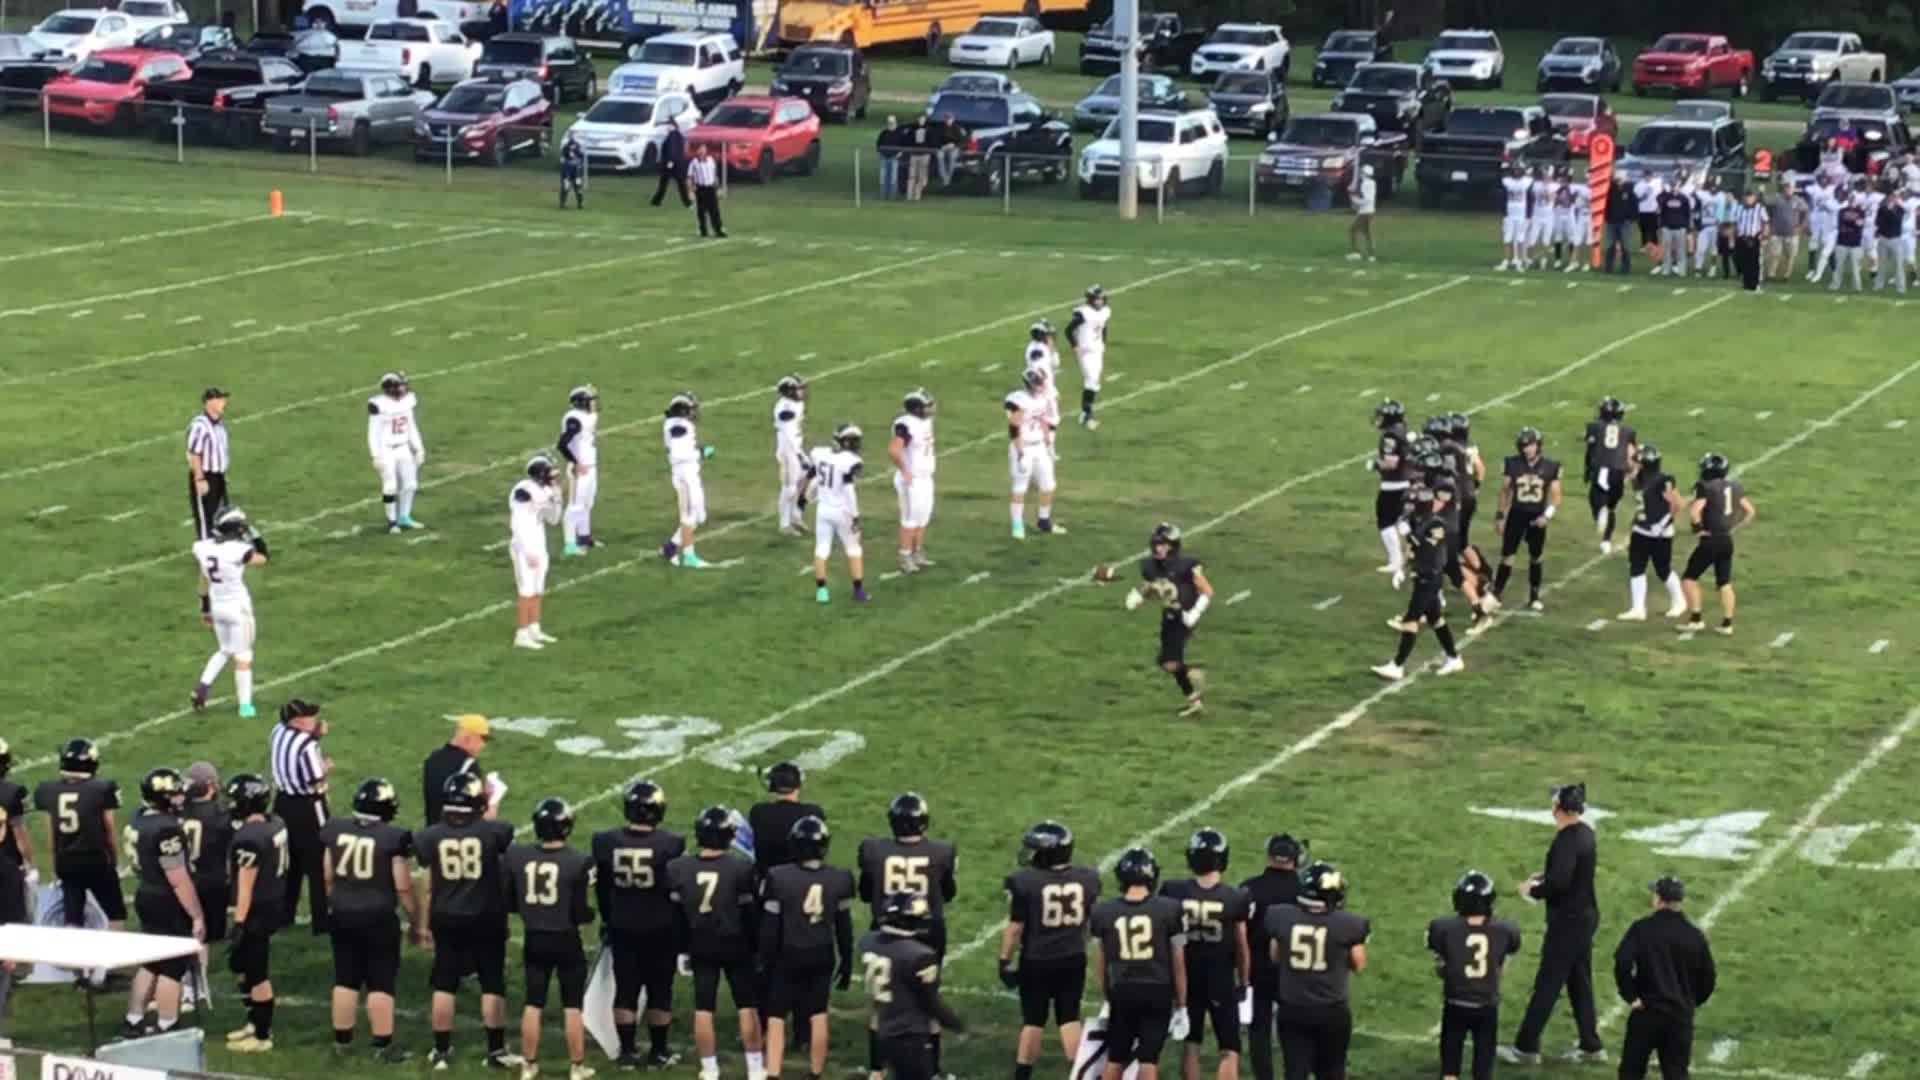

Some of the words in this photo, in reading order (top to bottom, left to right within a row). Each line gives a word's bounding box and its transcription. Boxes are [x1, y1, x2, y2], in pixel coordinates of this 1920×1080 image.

[1754, 149, 1774, 172] 2
[1604, 423, 1620, 449] 8
[816, 460, 834, 489] 51
[1515, 474, 1545, 503] 23
[1723, 485, 1733, 516] 1
[206, 555, 223, 584] 2
[58, 791, 80, 833] 5
[335, 832, 377, 880] 70
[438, 837, 483, 881] 68
[612, 847, 655, 889] 55
[884, 855, 930, 896] 65
[524, 860, 559, 906] 13
[696, 870, 719, 914] 7
[803, 882, 824, 924] 4
[1041, 882, 1085, 928] 63
[1113, 914, 1155, 961] 12
[1289, 924, 1329, 972] 51
[1464, 933, 1489, 979] 3
